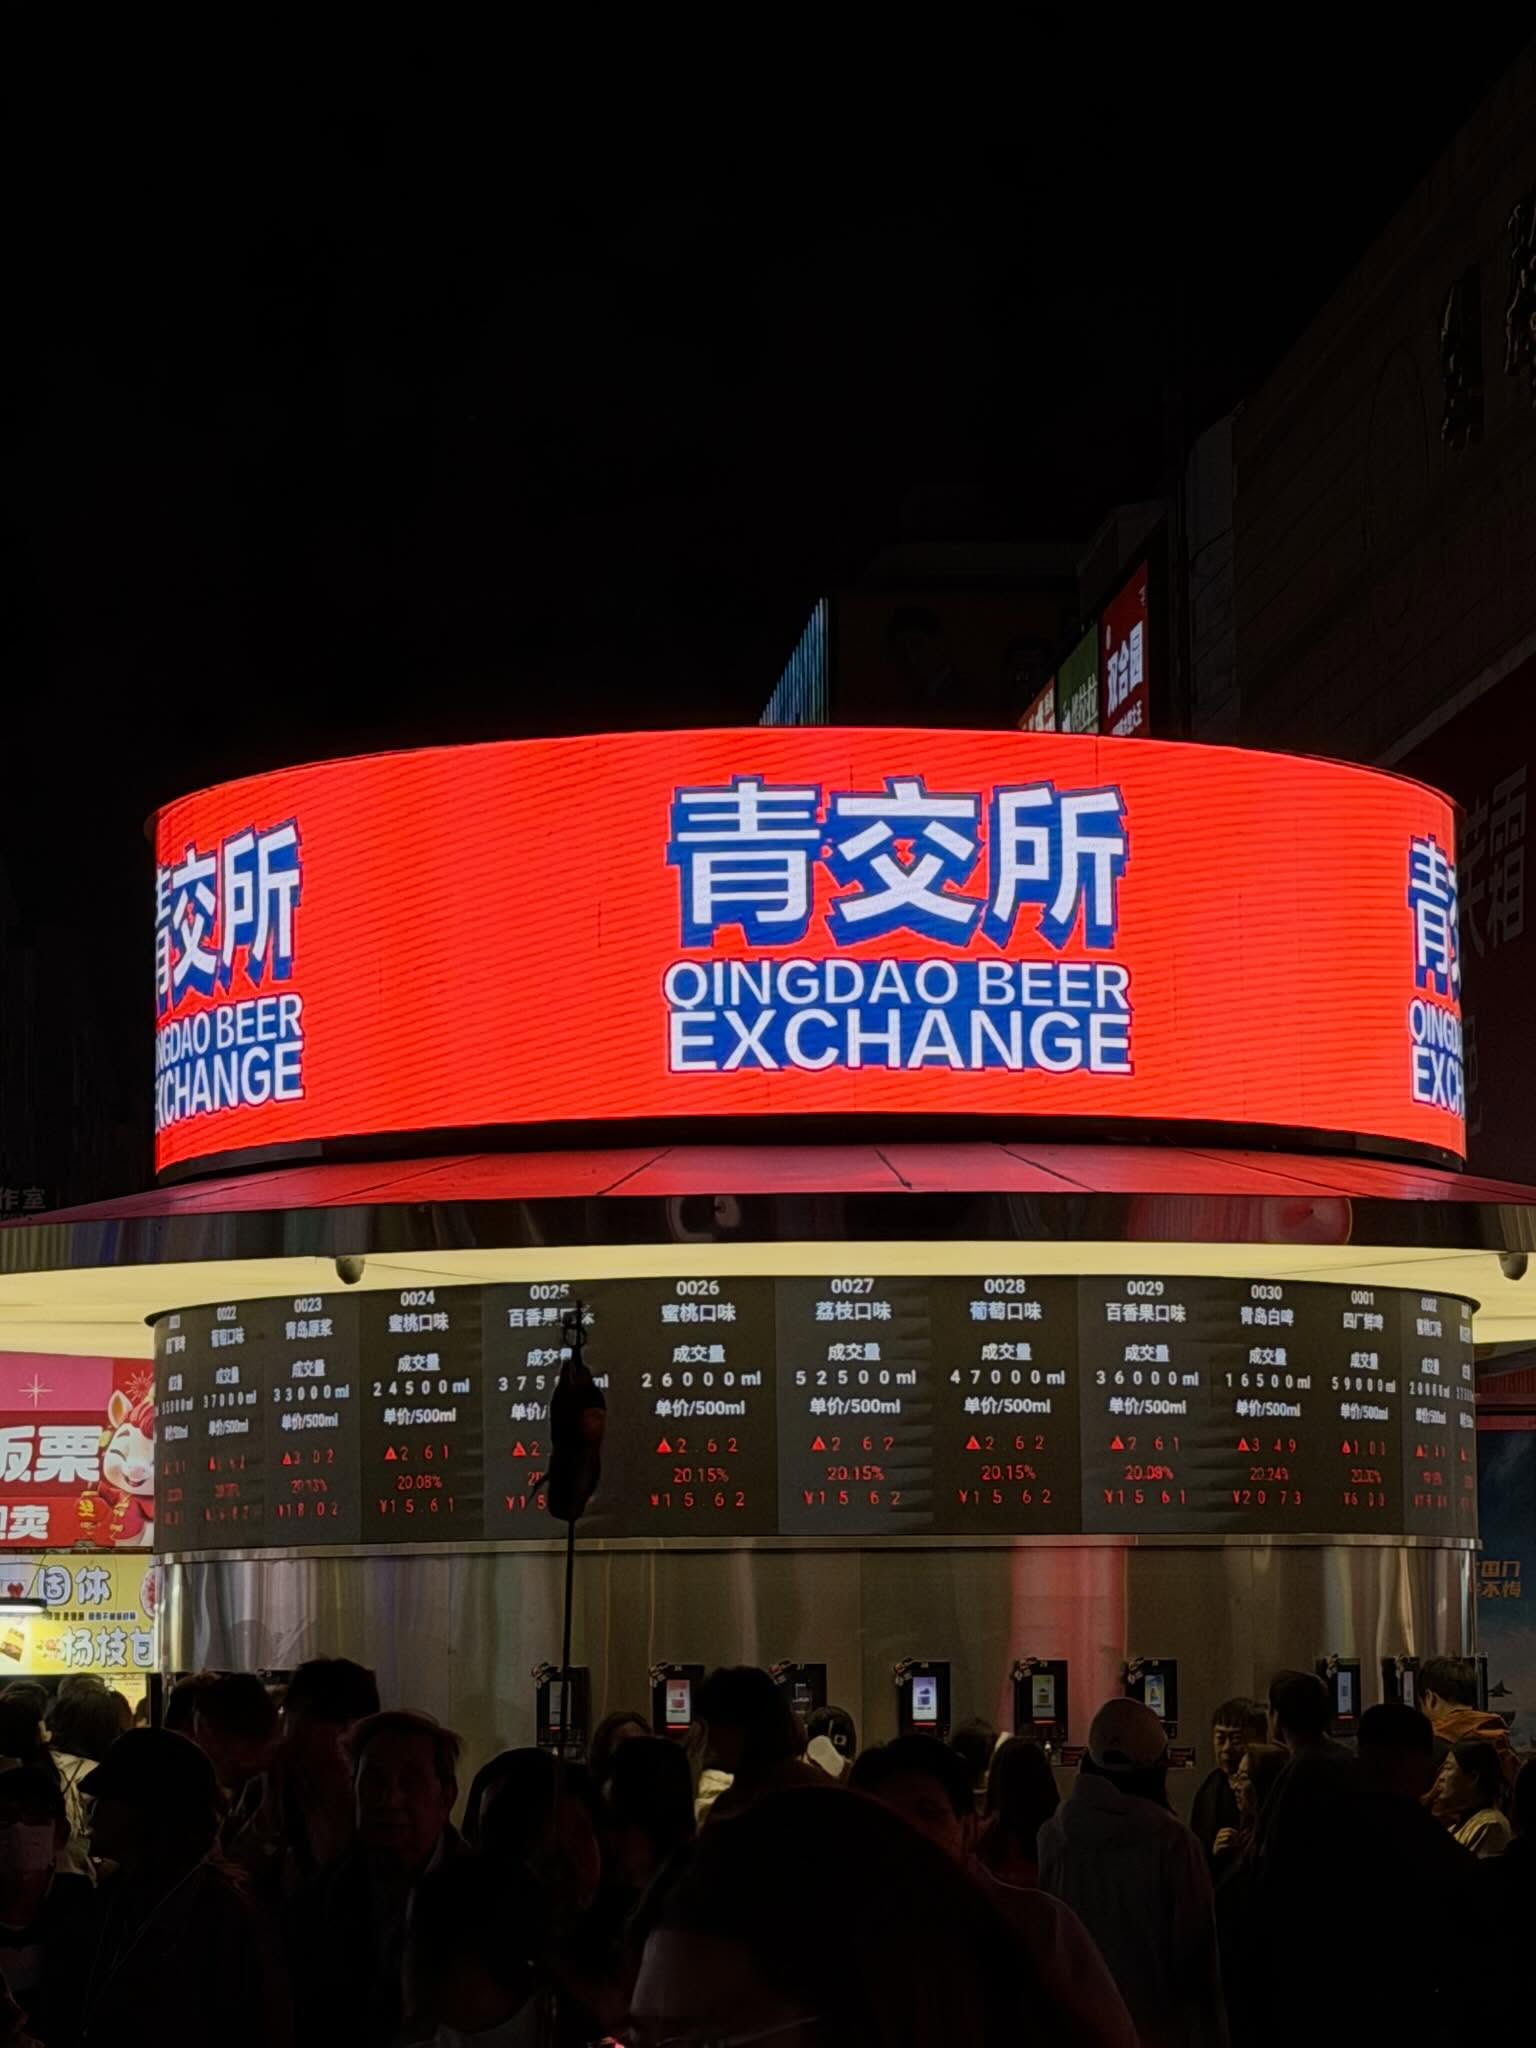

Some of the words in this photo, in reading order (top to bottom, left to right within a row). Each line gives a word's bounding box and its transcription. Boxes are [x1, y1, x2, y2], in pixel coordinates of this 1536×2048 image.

[675, 776, 1126, 930] 青交所
[663, 958, 958, 1010] QINGDAO
[977, 961, 1131, 1009] BEER
[216, 993, 304, 1049] BEER
[669, 1008, 1133, 1073] EXCHANGE
[529, 1283, 570, 1300] 0025
[676, 1279, 720, 1296] 0026
[830, 1277, 875, 1294] 0027
[983, 1278, 1026, 1294] 0028
[1126, 1280, 1164, 1297] 0029
[1251, 1285, 1283, 1300] 0030
[293, 1296, 322, 1313] 0023
[400, 1290, 436, 1307] 0024
[1351, 1290, 1374, 1305] 0001
[661, 1302, 737, 1323] 蜜桃口味
[815, 1300, 892, 1321] 荔枝口味
[969, 1300, 1042, 1321] 葡萄口味
[1105, 1302, 1186, 1323] 百香果口味
[1240, 1306, 1294, 1327] 青岛白啤
[285, 1319, 333, 1340] 青岛原浆
[388, 1312, 449, 1333] 蜜桃口味
[672, 1344, 726, 1364] 成交量
[827, 1342, 881, 1362] 成交量
[981, 1342, 1033, 1361] 成交量
[1124, 1343, 1170, 1363] 成交量
[1249, 1347, 1287, 1366] 成交量
[1350, 1351, 1379, 1370] 成交量
[291, 1359, 326, 1378] 成交量
[397, 1352, 441, 1373] 成交量
[655, 1398, 746, 1418] 单价/500ml
[809, 1396, 901, 1416] 单价/500ml
[964, 1396, 1051, 1415] 单价/500ml
[1108, 1396, 1187, 1415] 单价/500ml
[1235, 1399, 1301, 1418] 单价/500ml
[1340, 1402, 1389, 1420] 单价/500ml
[281, 1412, 339, 1431] 单价/500ml
[383, 1407, 457, 1426] 单价/500ml
[671, 1467, 729, 1484] 20.15%
[826, 1465, 885, 1482] 20.15%
[980, 1465, 1037, 1482] 20.15%
